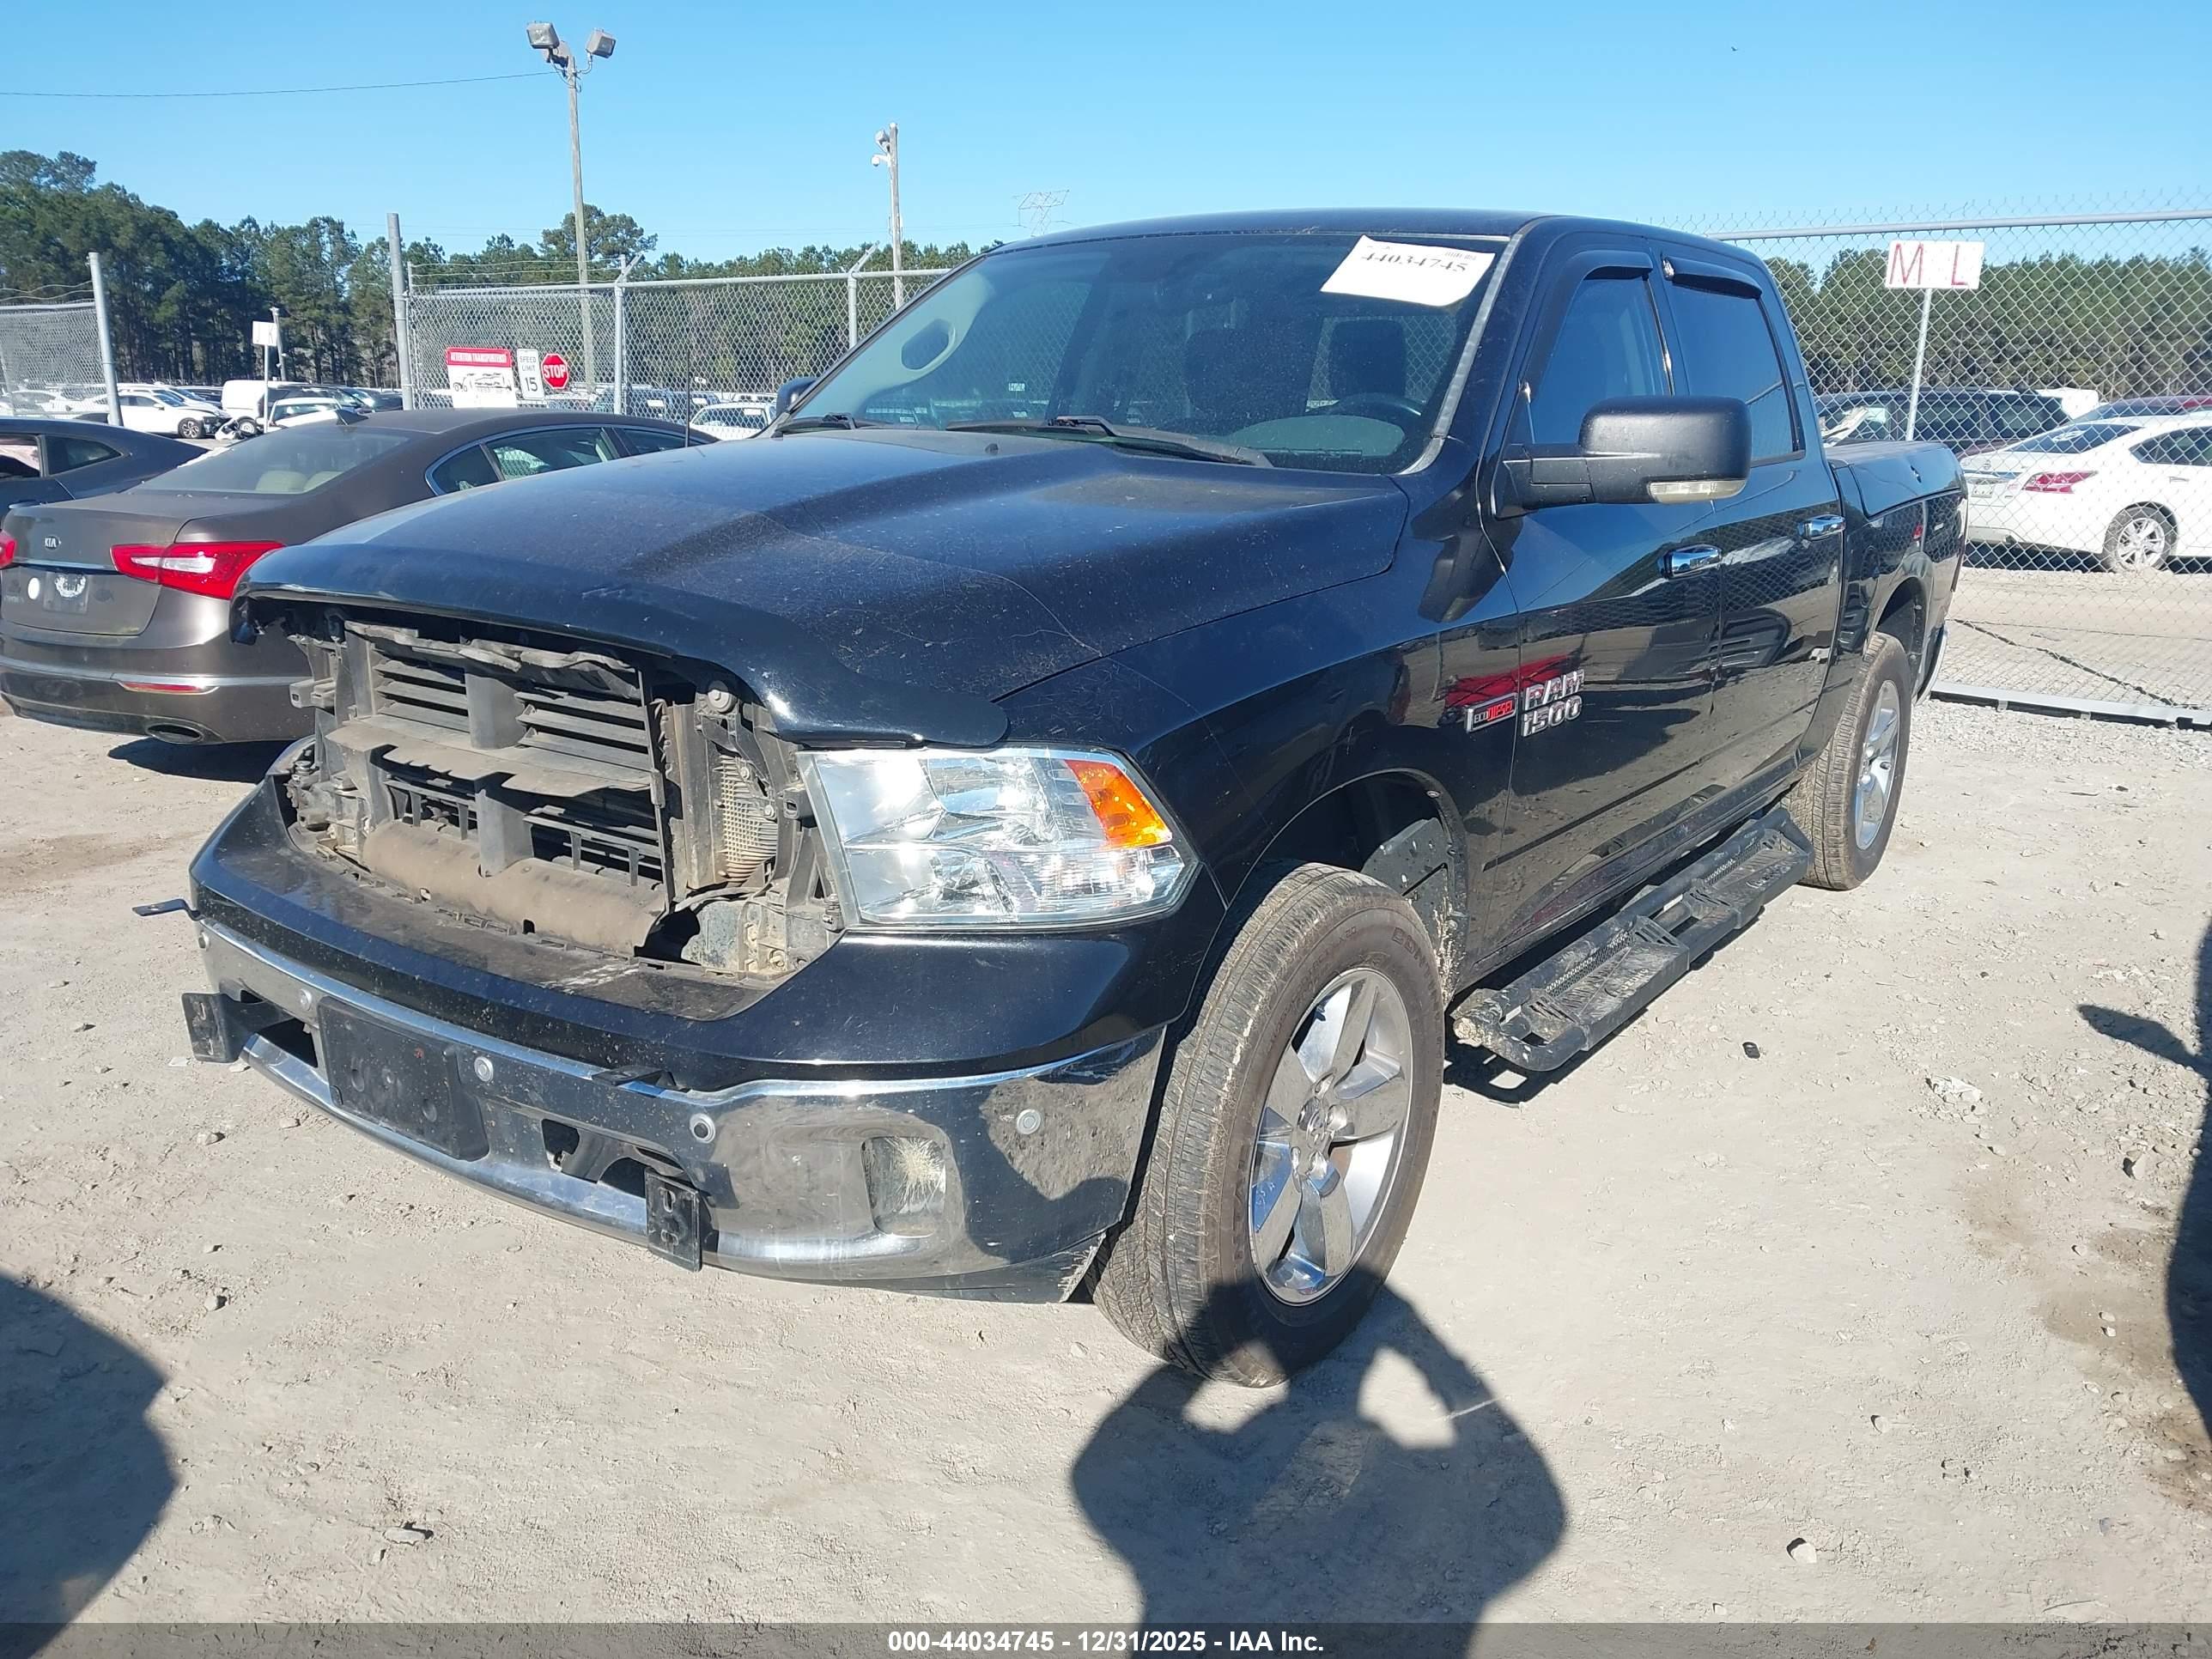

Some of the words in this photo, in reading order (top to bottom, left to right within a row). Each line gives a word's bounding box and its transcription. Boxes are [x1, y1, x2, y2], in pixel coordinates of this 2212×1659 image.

[1889, 242, 1924, 285] M
[1950, 243, 1969, 286] L
[525, 376, 538, 392] 15
[543, 363, 567, 379] STOP
[44, 538, 57, 548] KIA
[1524, 669, 1585, 712] RAM
[1522, 695, 1582, 737] 1500
